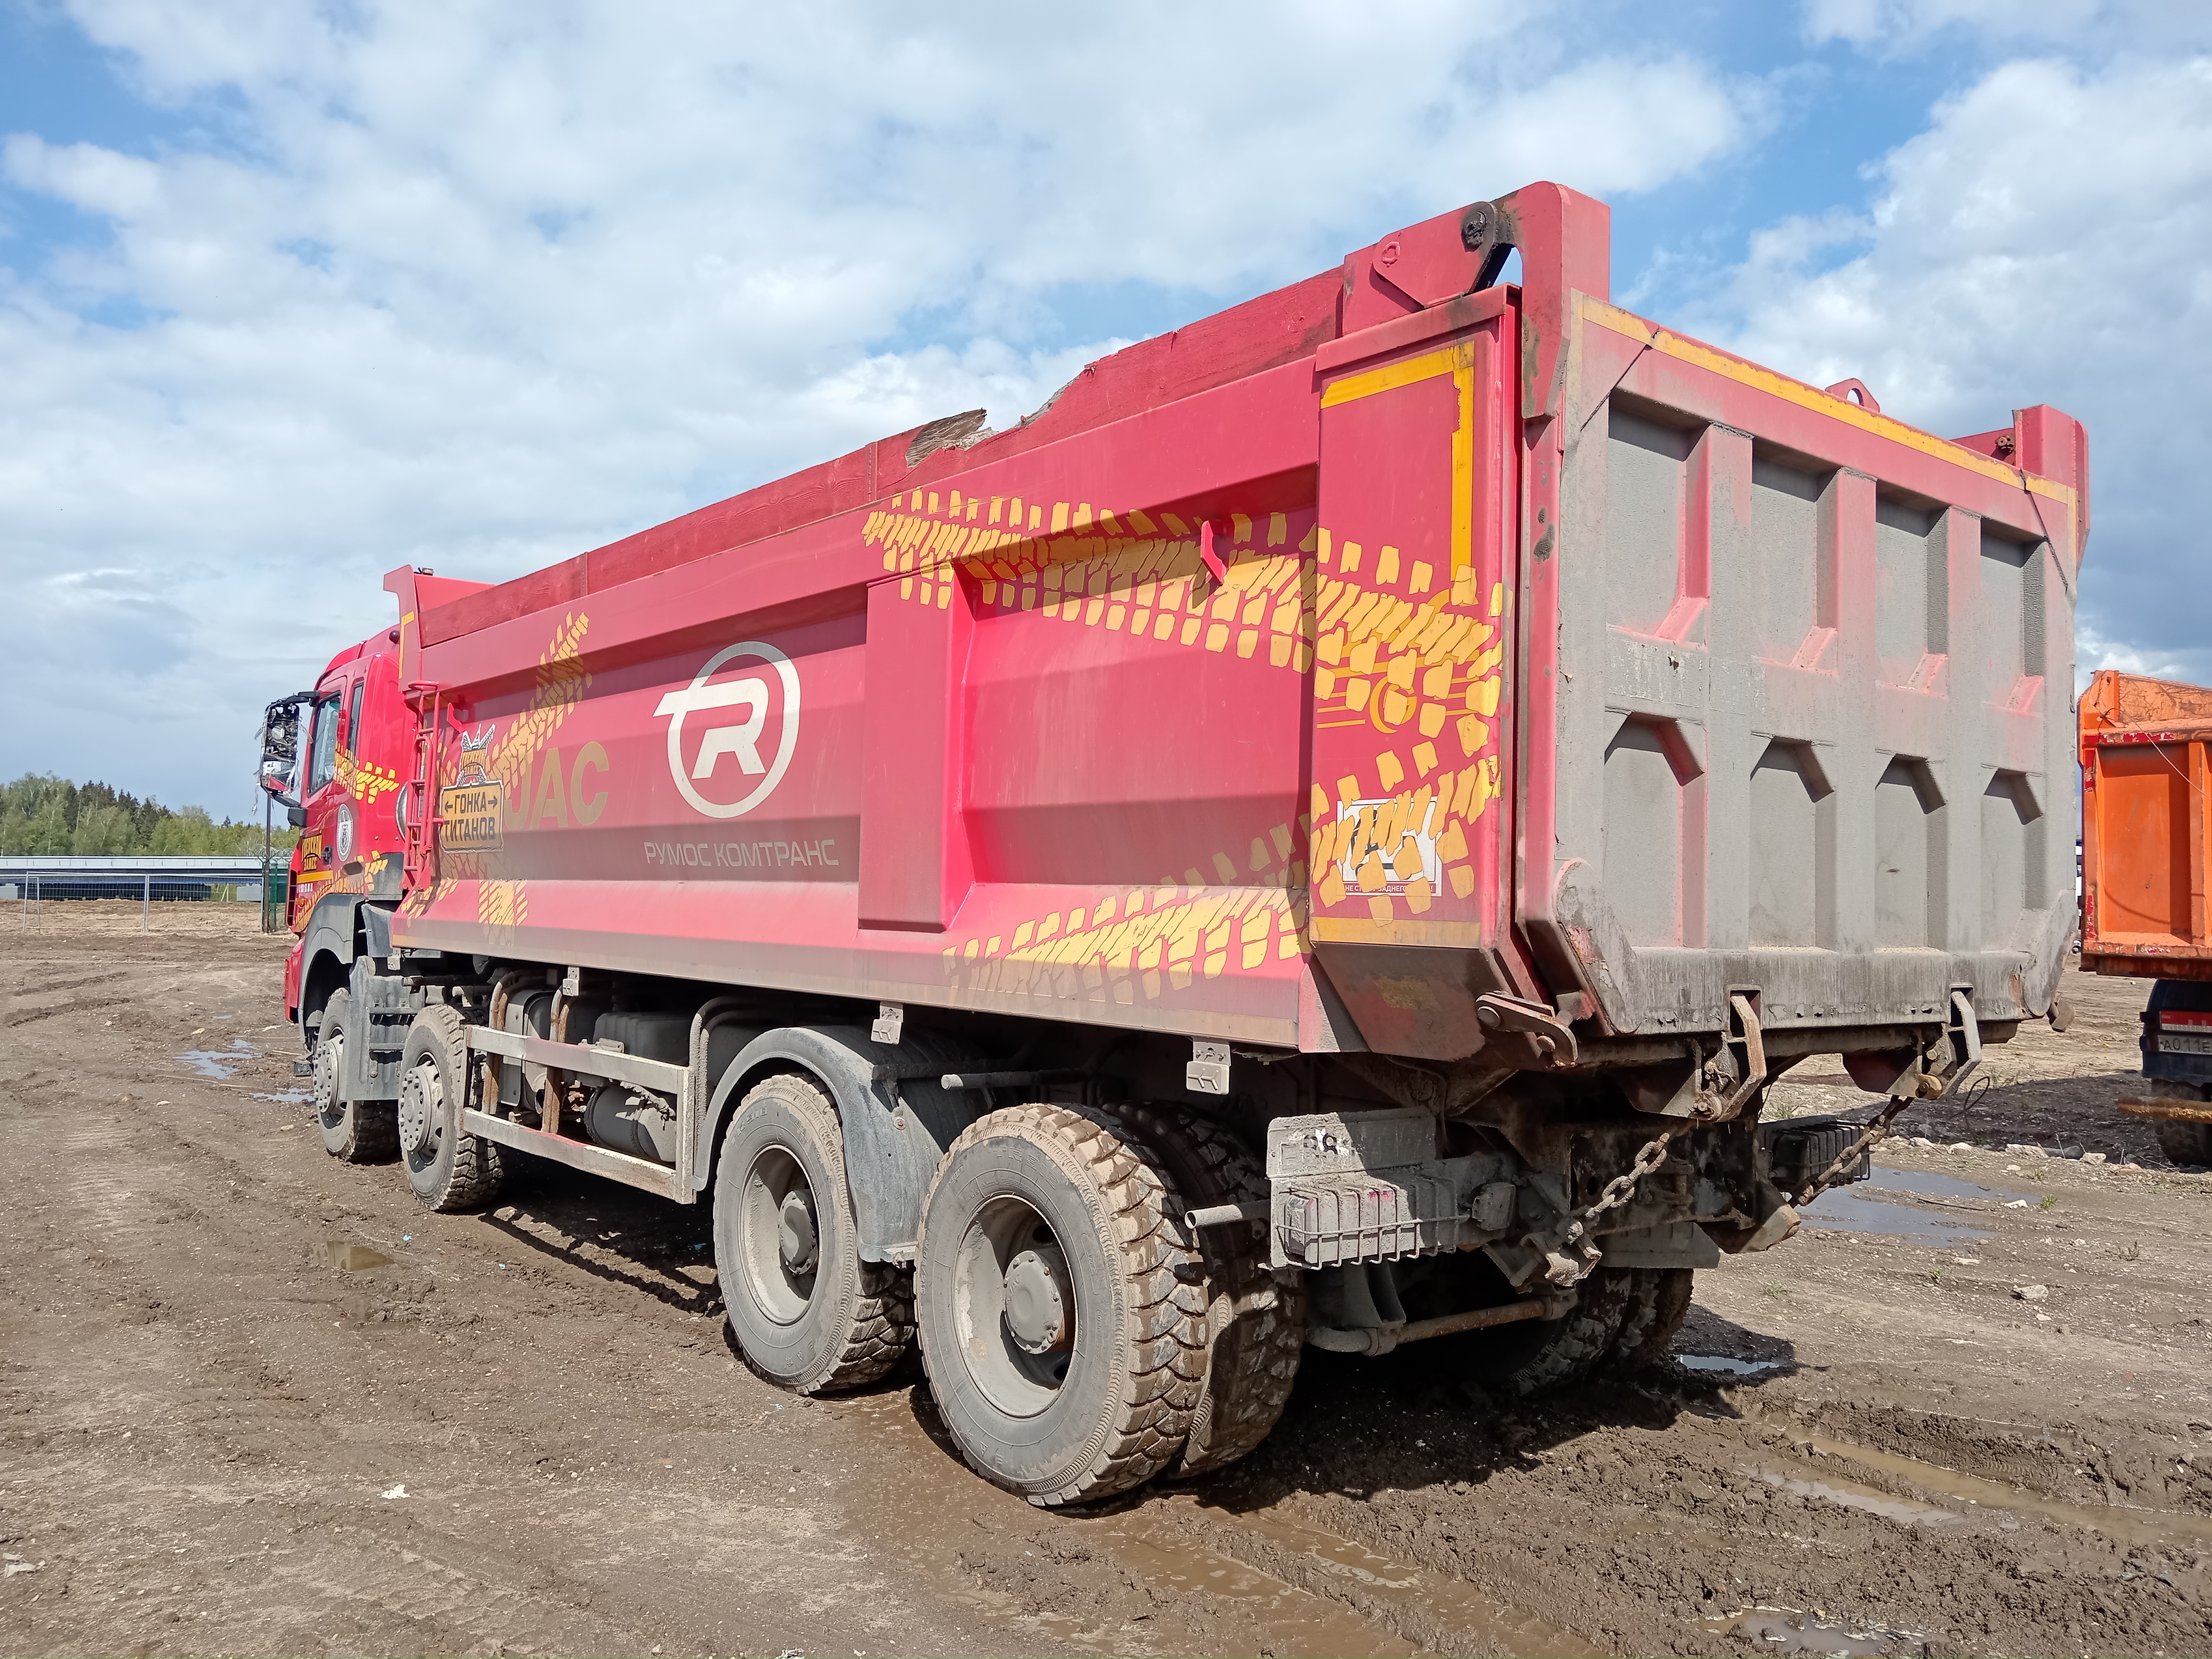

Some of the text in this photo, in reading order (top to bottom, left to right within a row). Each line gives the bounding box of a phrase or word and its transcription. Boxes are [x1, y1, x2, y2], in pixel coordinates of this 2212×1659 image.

[504, 741, 610, 830] JAC
[454, 792, 487, 814] ГОНКА
[443, 816, 496, 842] ТИТАНОВ
[644, 839, 839, 867] РУМОС КОМТРАНС
